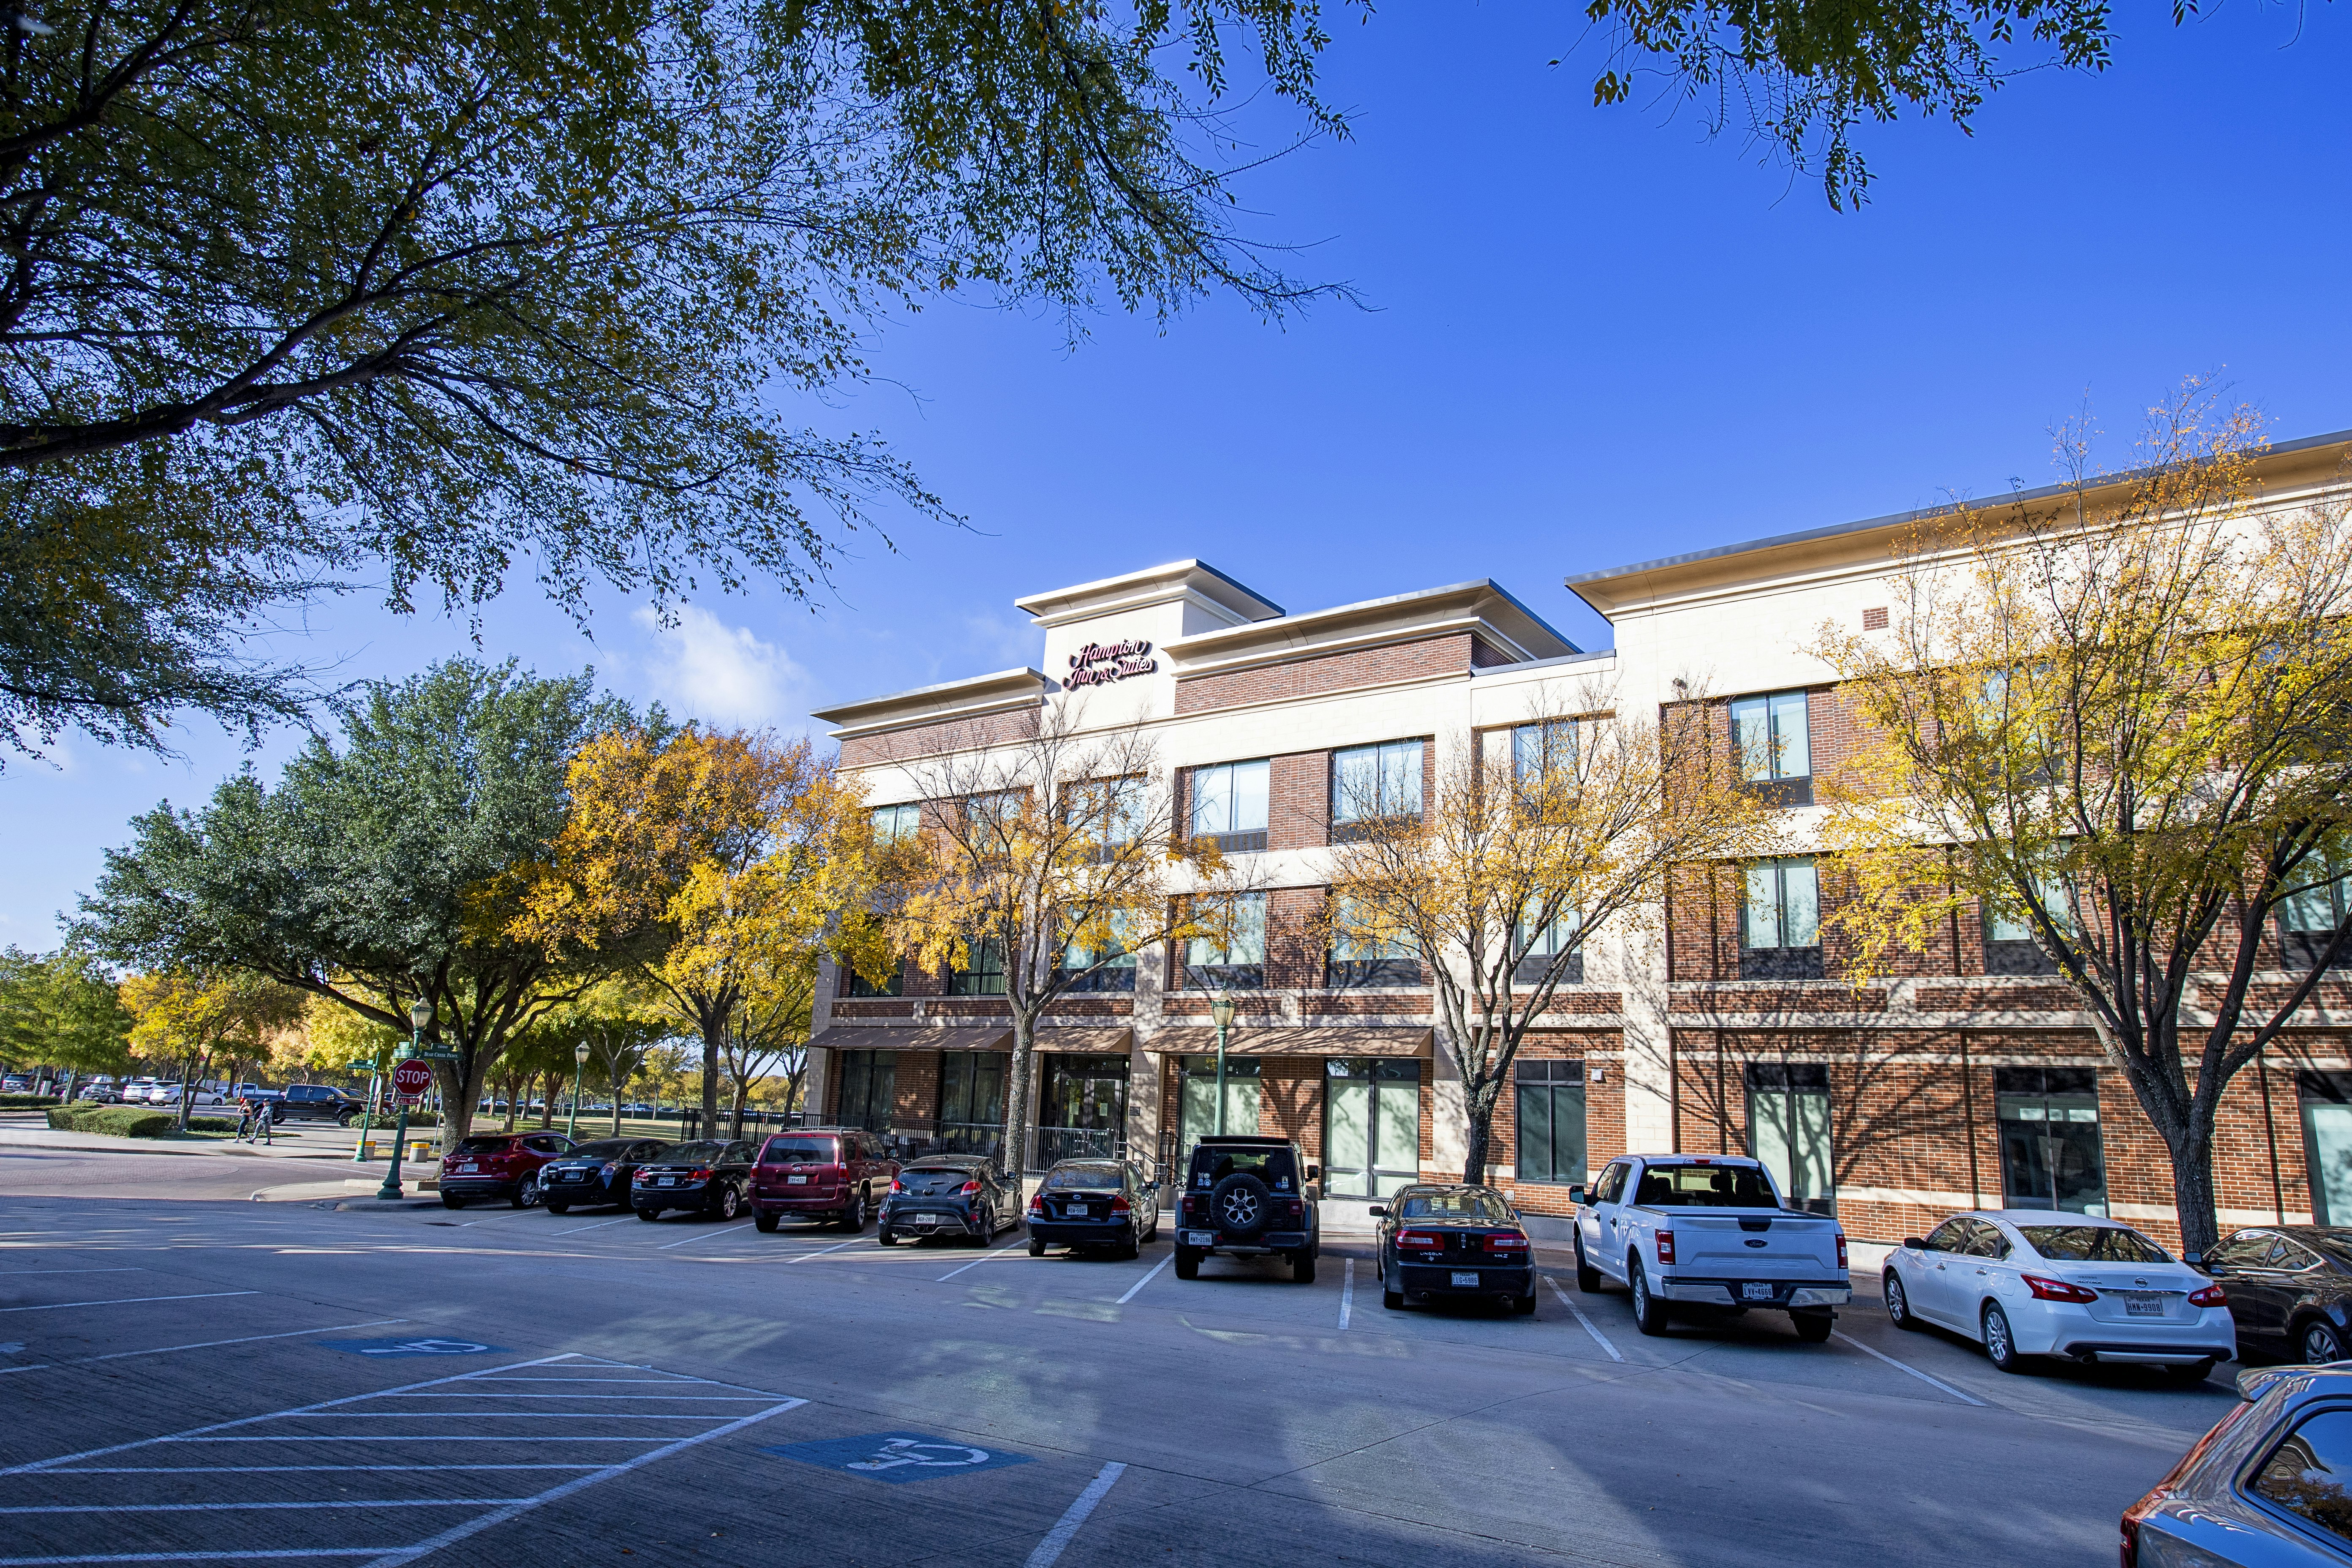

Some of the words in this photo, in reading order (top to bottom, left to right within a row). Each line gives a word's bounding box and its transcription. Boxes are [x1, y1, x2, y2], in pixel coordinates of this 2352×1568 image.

[1069, 639, 1149, 669] Hampton
[1062, 667, 1100, 689] Inn
[1100, 667, 1110, 681] &
[1109, 658, 1153, 678] Suites
[397, 1070, 429, 1084] STOP
